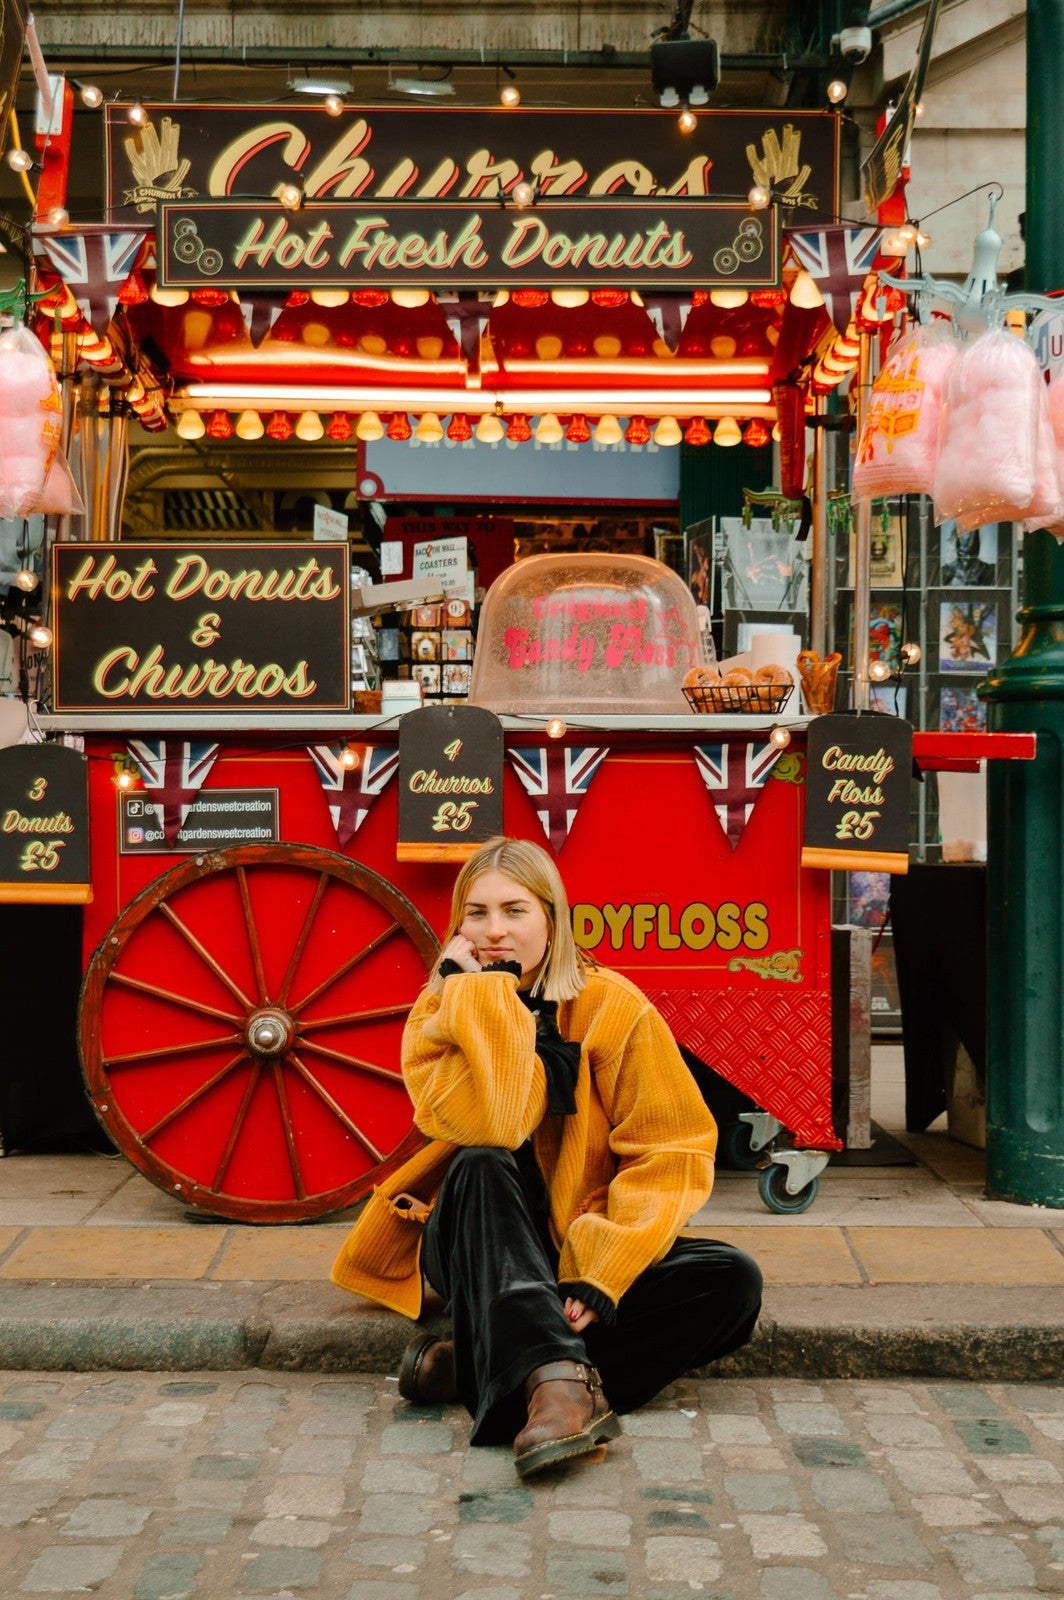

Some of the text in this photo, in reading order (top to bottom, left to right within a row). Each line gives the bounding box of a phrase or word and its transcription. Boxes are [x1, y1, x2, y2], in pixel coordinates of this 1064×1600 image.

[209, 119, 713, 197] Churros
[234, 214, 694, 270] Hot Fresh Donuts
[401, 521, 497, 533] THIS WAY TO
[68, 554, 158, 601] Hot
[166, 554, 342, 601] Donuts
[420, 557, 458, 571] COASTERS
[533, 593, 646, 623] Original
[191, 612, 222, 648] &
[504, 623, 676, 672] Candy Floss
[93, 644, 318, 698] Churros
[444, 738, 463, 762] 4
[822, 745, 895, 784] Candy
[29, 776, 49, 801] 3
[409, 769, 494, 795] Churros
[827, 779, 885, 806] Floss
[3, 809, 76, 833] Donuts
[145, 800, 272, 815] @ardensweetcreation
[432, 801, 479, 832] £5
[145, 827, 272, 842] @contgardensweetcreation
[835, 811, 882, 840] £5
[20, 840, 66, 872] £5
[570, 901, 770, 951] DYFLOSS
